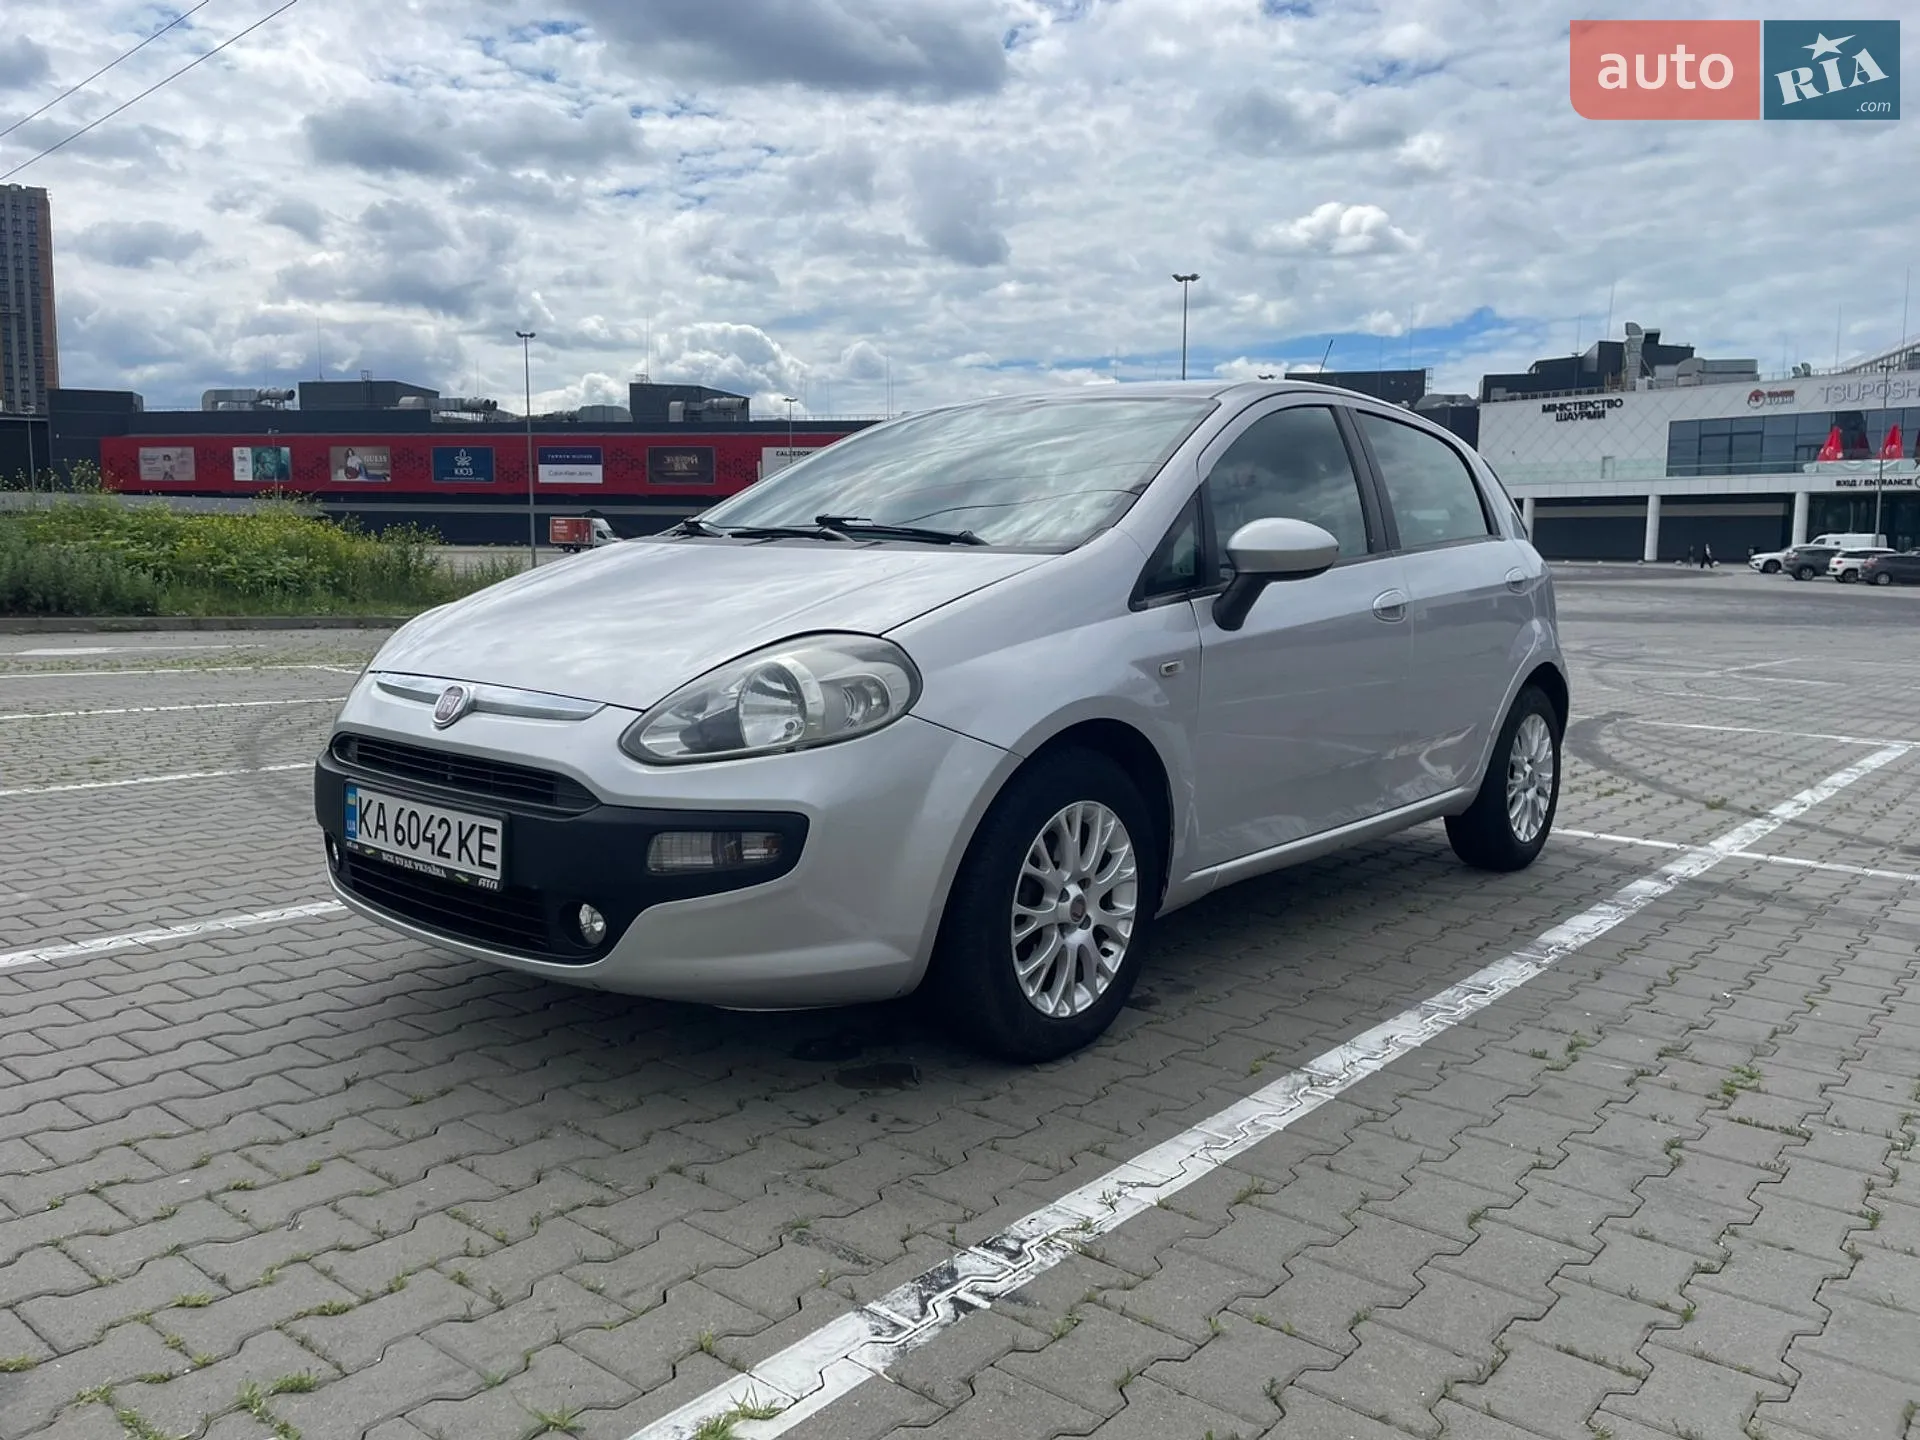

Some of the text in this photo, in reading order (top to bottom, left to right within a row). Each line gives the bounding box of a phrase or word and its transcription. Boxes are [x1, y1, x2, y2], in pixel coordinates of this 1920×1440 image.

[1542, 398, 1624, 413] МІНІСТЕРСТВО
[1556, 410, 1606, 422] ШАУРМИ
[358, 796, 498, 871] KA 6042 KE
